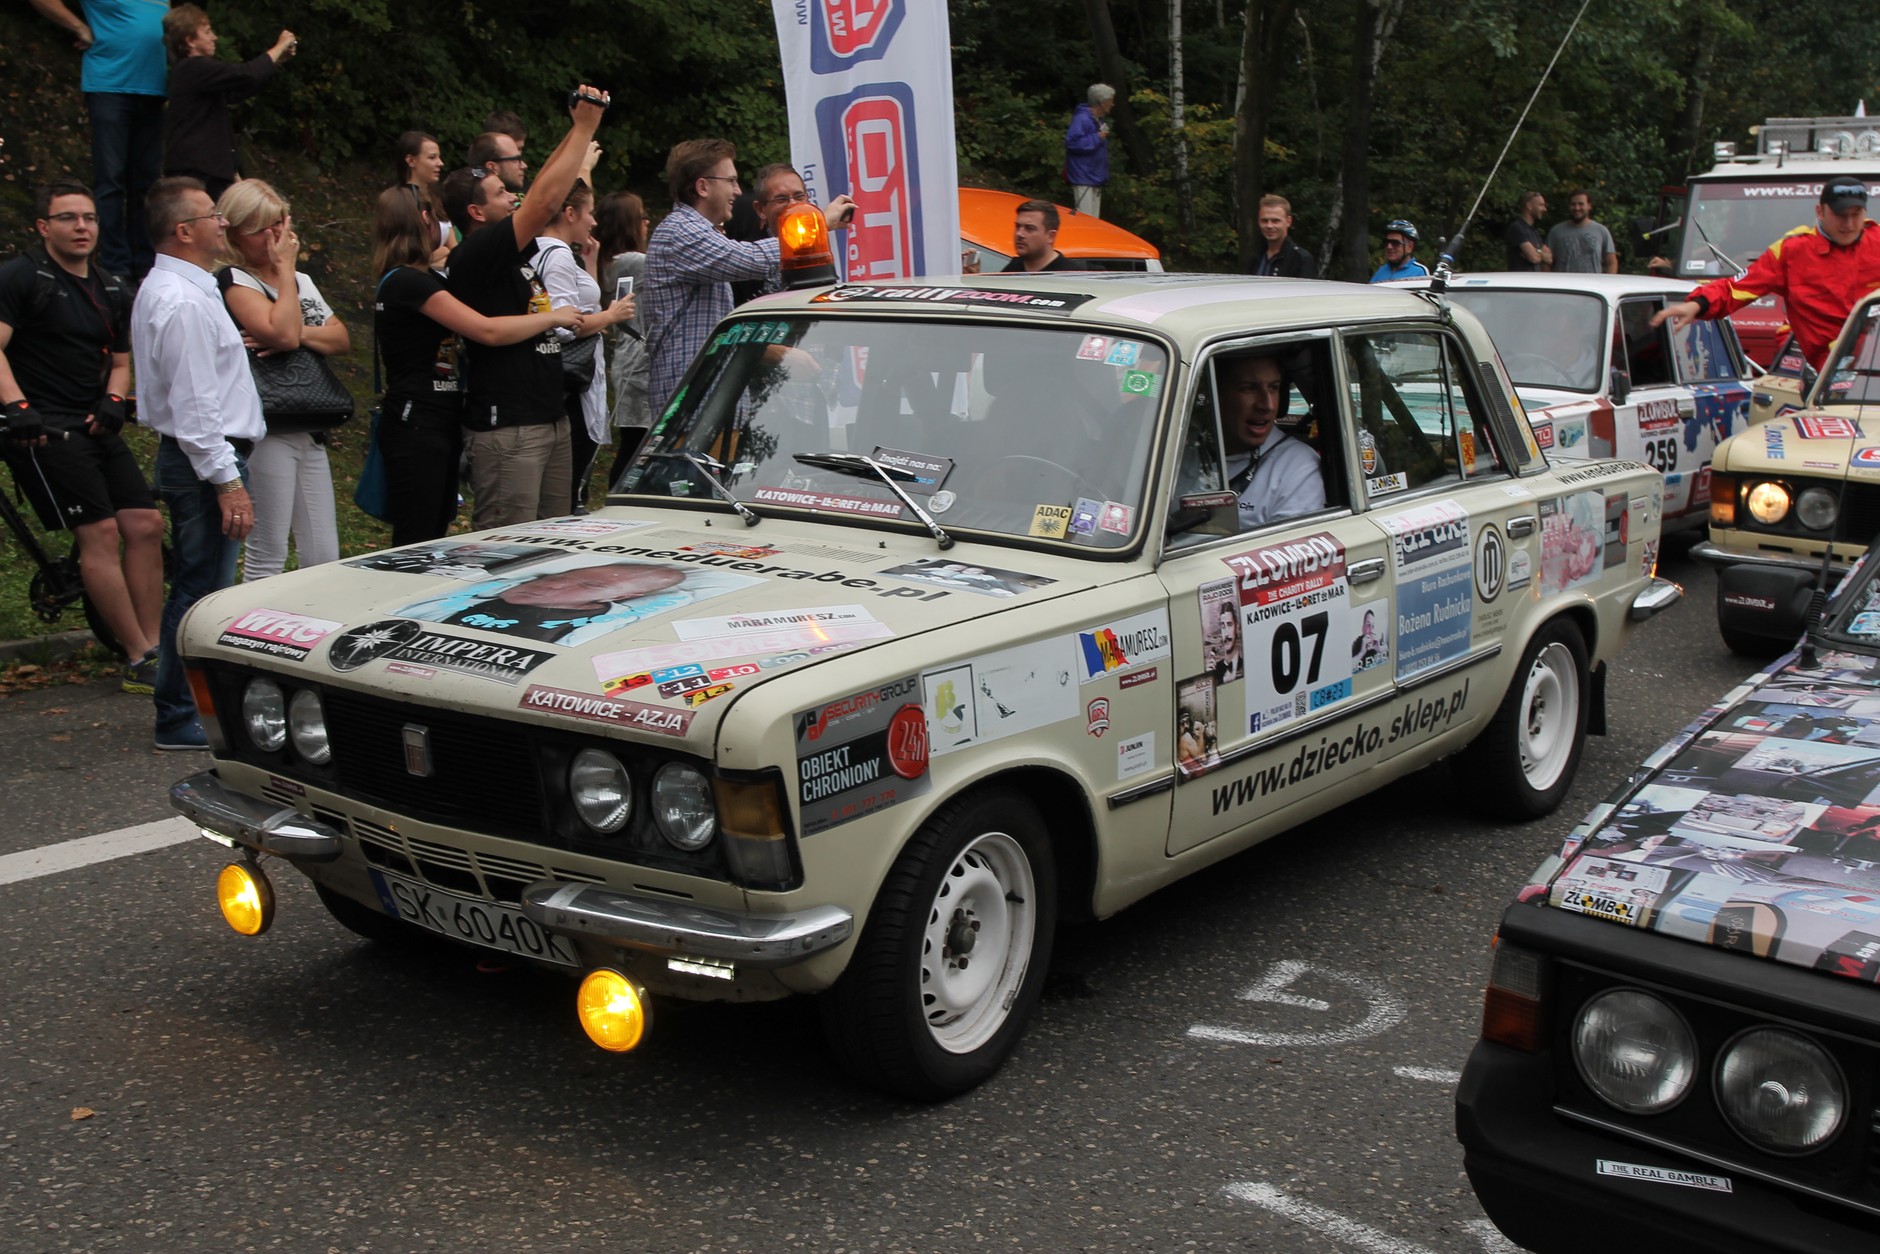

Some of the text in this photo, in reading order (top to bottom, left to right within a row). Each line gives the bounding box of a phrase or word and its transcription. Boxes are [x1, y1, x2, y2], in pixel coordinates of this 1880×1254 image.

[878, 453, 908, 468] Znajdź
[908, 459, 923, 469] nas
[1645, 437, 1677, 472] 259
[1036, 506, 1069, 519] ADAC
[480, 533, 952, 602] www.eneduerabe.pl
[1279, 584, 1304, 599] CHARITY
[1305, 577, 1325, 591] RALLY
[1328, 585, 1345, 598] MAR
[1421, 580, 1438, 593] Biuro
[1399, 612, 1431, 637] Bożena
[1433, 592, 1472, 624] Rudnicka
[220, 634, 265, 649] magazyn
[408, 634, 535, 670] IMPERA
[1271, 611, 1328, 695] 07
[396, 648, 518, 680] INTERNATIONAL
[528, 690, 625, 718] KATOWICE
[633, 708, 683, 731] AZJA
[801, 746, 850, 780] OBIEKT
[803, 757, 880, 802] CHRONIONY
[391, 881, 446, 931] SK
[1611, 1164, 1628, 1174] THE
[1632, 1167, 1665, 1179] REAL
[1668, 1172, 1718, 1187] GAMBLE
